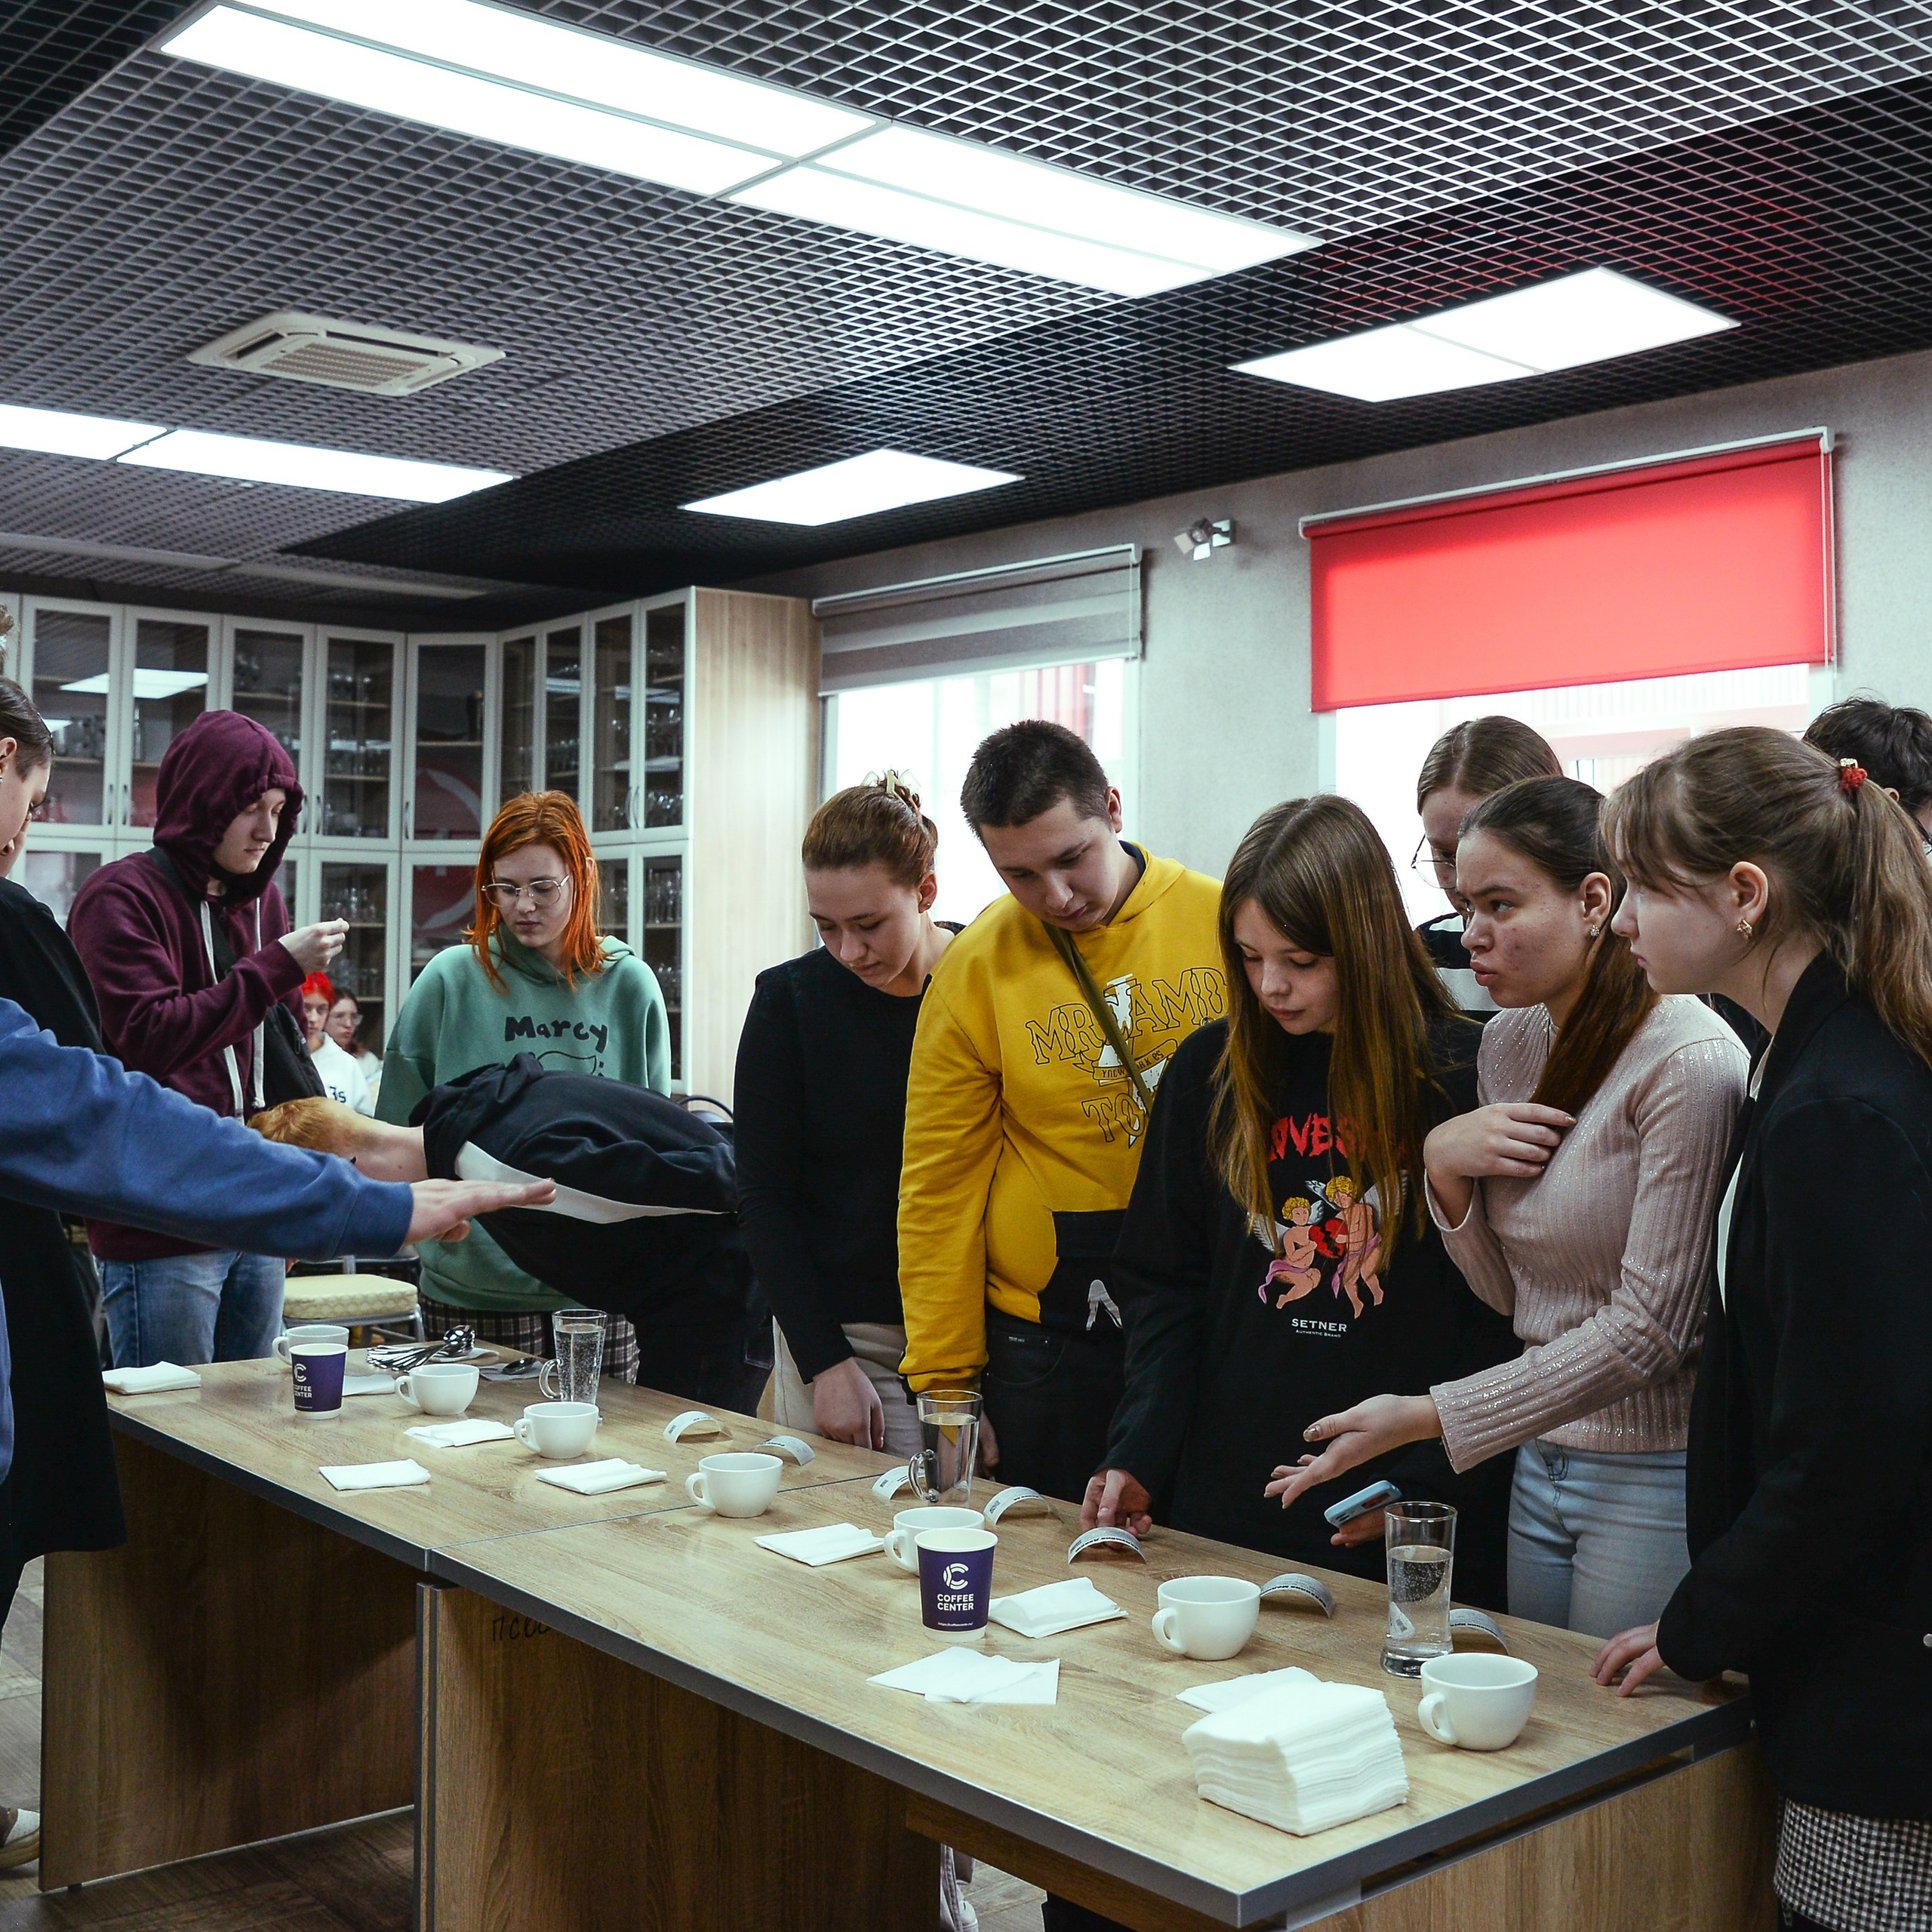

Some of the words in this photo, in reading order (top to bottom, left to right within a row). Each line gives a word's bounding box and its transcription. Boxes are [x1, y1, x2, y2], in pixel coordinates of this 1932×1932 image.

[504, 1016, 608, 1054] Marcy
[1291, 1318, 1347, 1332] SETNER
[937, 1593, 974, 1602] COFFEE
[937, 1602, 974, 1611] CENTER
